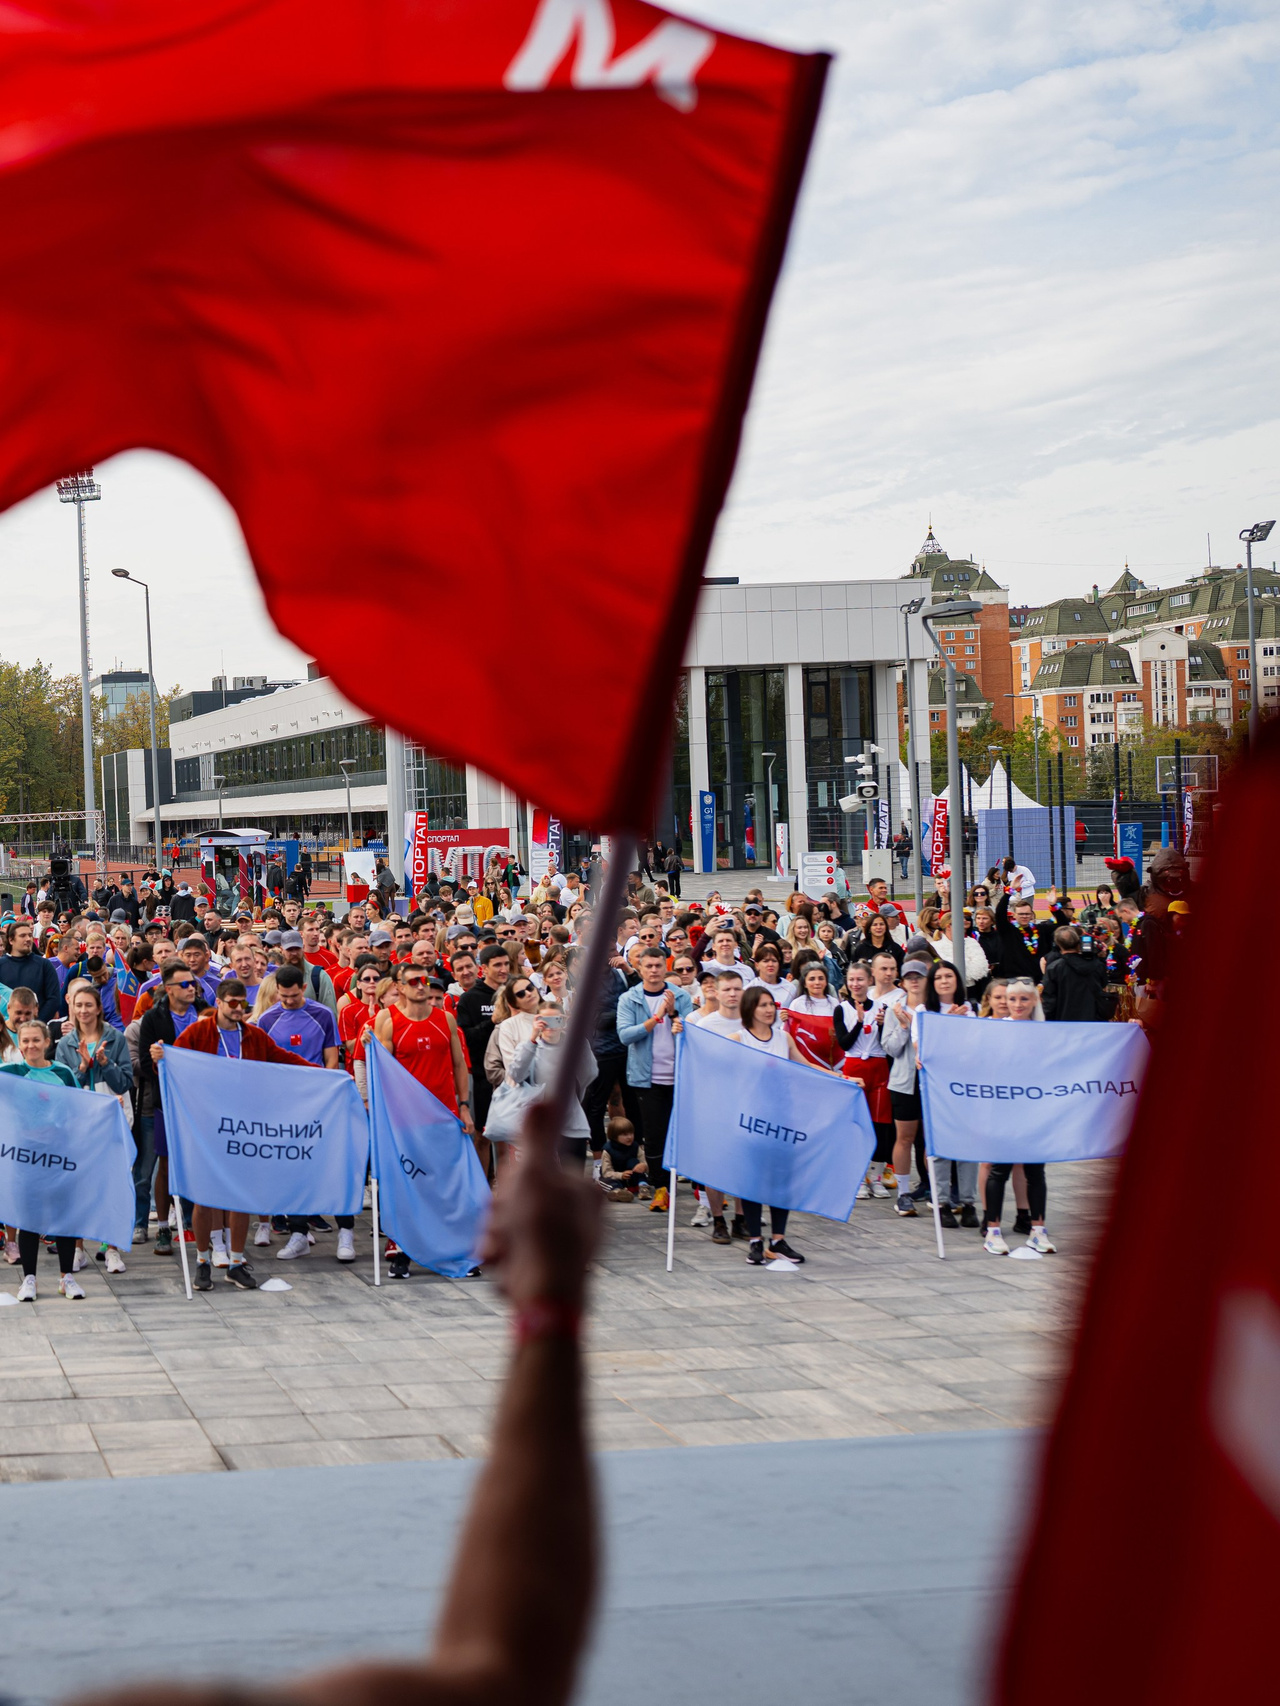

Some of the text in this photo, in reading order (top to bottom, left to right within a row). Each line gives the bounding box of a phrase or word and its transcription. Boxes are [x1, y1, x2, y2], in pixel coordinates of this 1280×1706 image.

[427, 835, 460, 843] СПОРТАП
[427, 845, 510, 883] МТС
[949, 1079, 1139, 1100] СЕВЕРО-ЗАПАД
[217, 1116, 323, 1139] ДАЛЬНИЙ
[739, 1112, 808, 1145] ЦЕНТР
[226, 1139, 314, 1161] ВОСТОК
[400, 1153, 427, 1180] ЮГ
